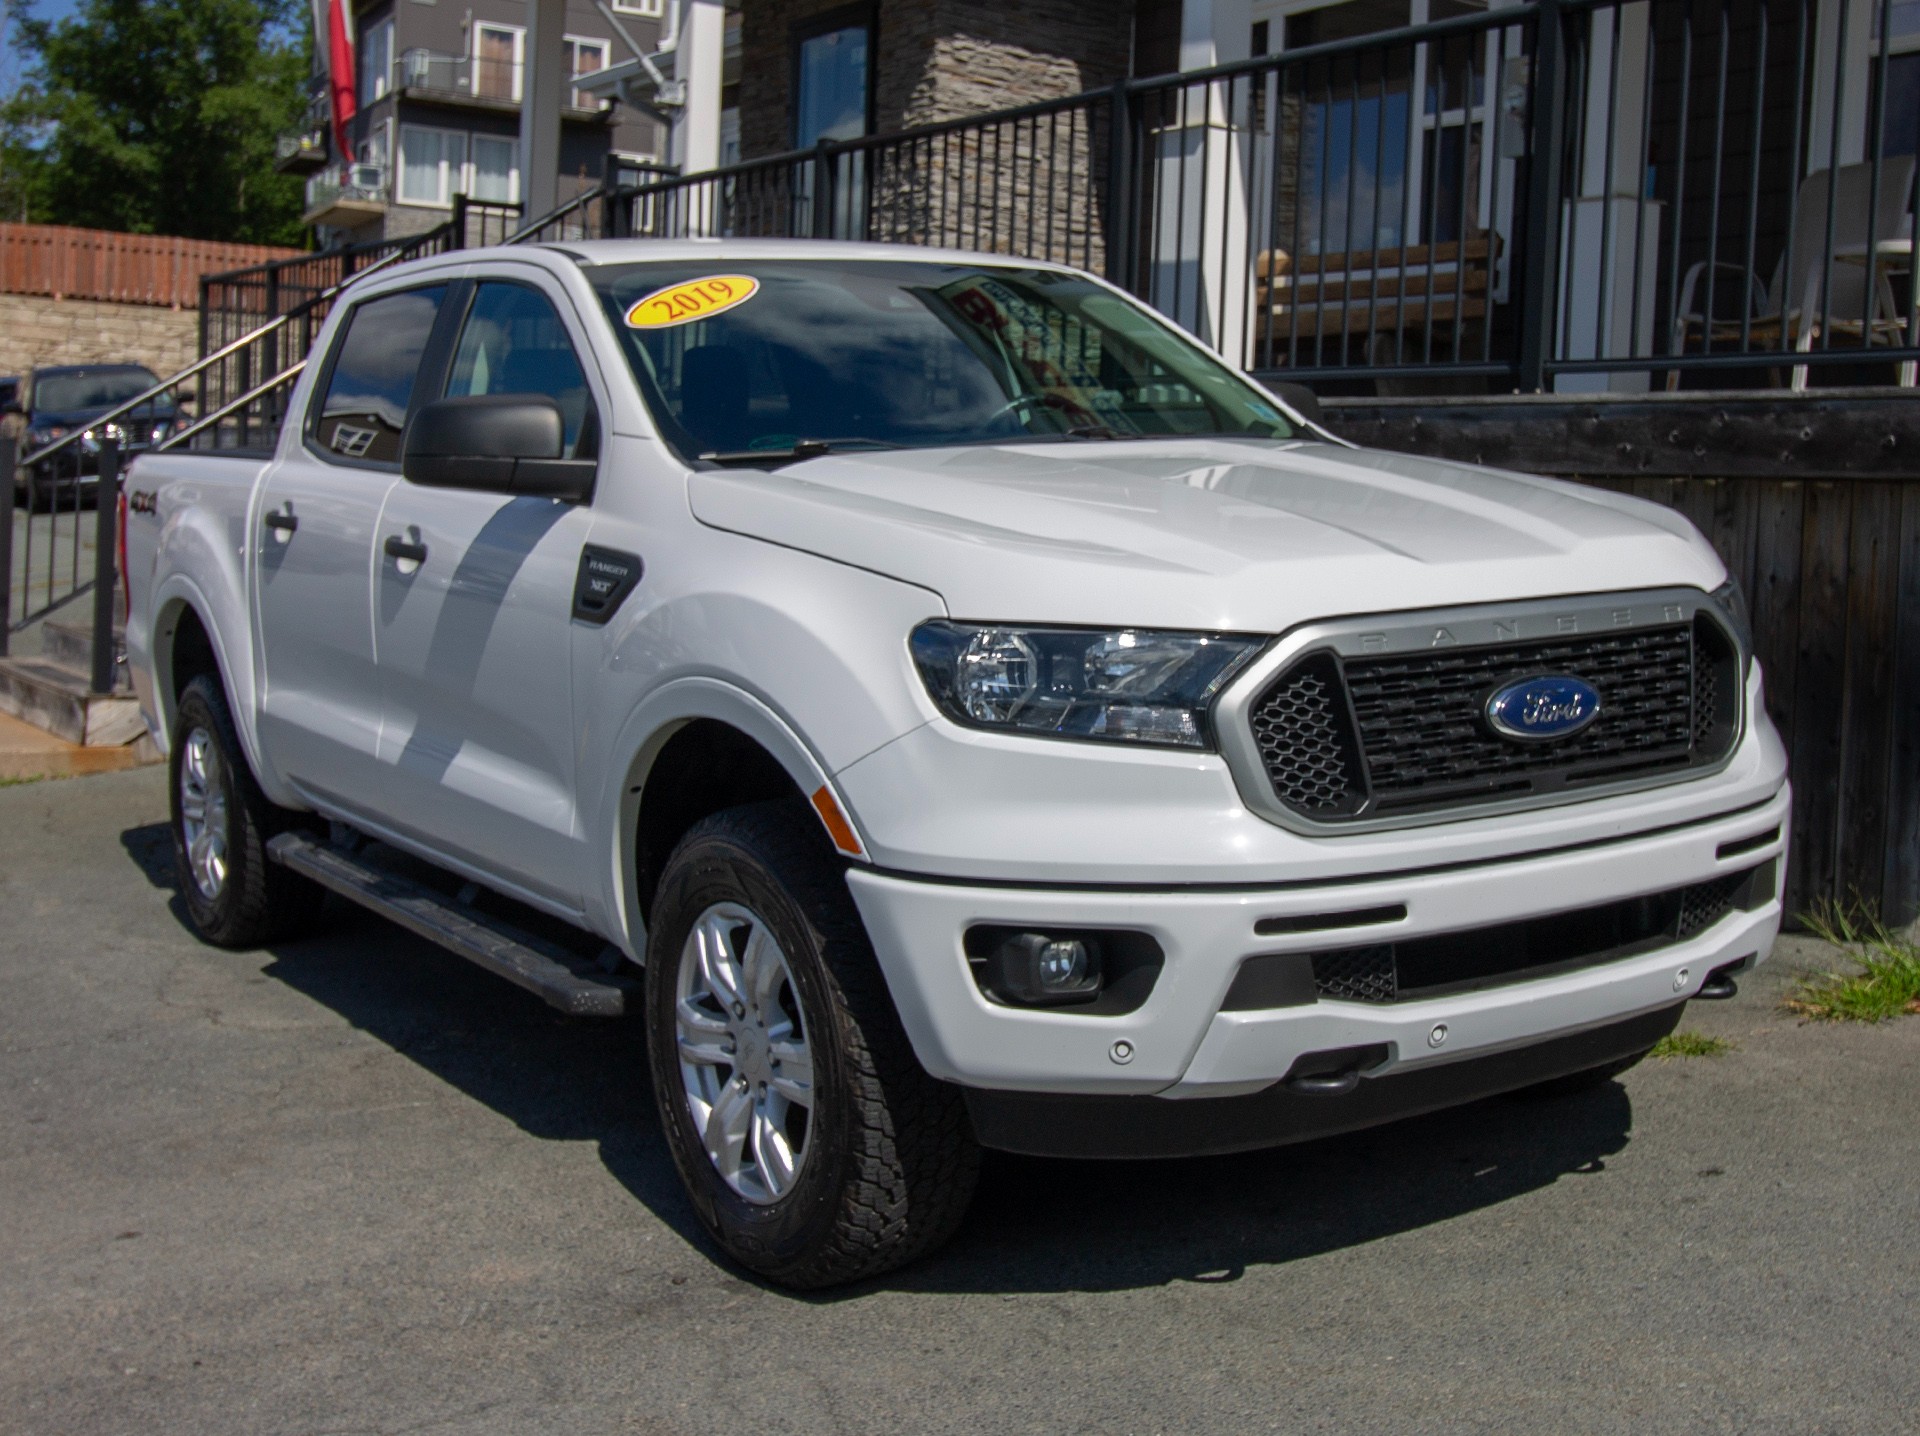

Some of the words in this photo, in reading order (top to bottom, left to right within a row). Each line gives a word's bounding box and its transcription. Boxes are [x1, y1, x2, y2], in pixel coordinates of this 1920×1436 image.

[652, 281, 733, 320] 2019
[589, 561, 628, 576] RANGER
[1358, 604, 1683, 650] RANGER
[1522, 688, 1582, 725] Ford
